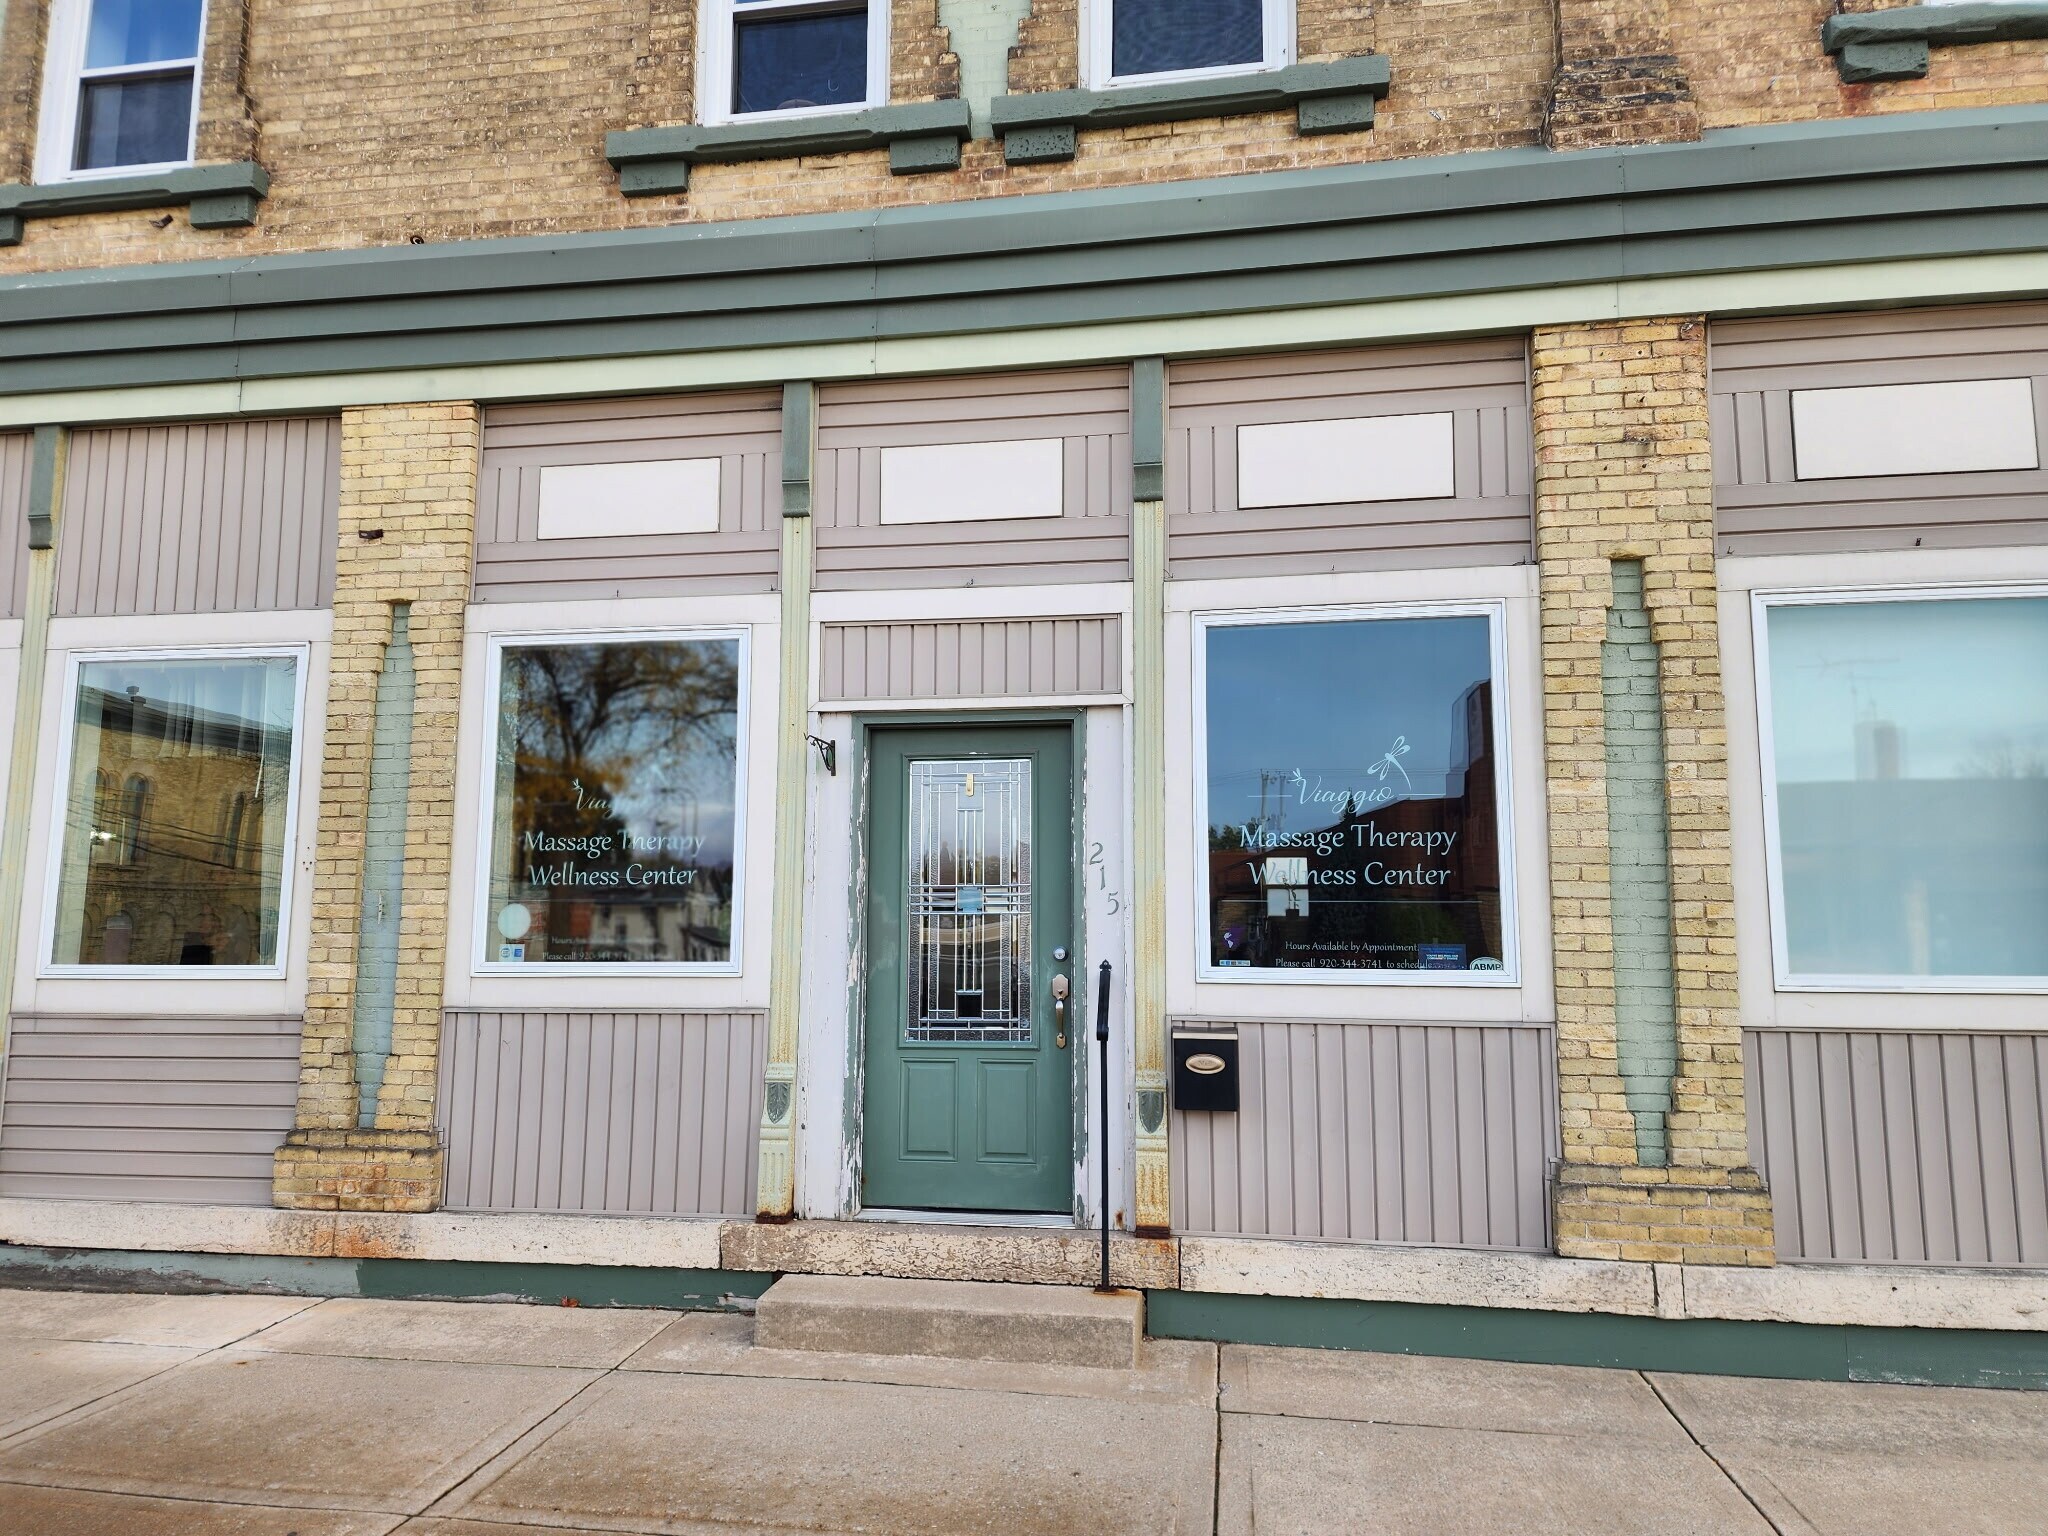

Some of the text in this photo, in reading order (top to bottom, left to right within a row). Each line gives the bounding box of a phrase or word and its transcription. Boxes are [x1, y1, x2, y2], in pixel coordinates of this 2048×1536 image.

[1297, 774, 1395, 814] Viaggio
[524, 828, 705, 859] Massage Therapy
[1239, 820, 1456, 856] Massage Therapy
[528, 861, 698, 886] Wellness Center
[1246, 858, 1451, 885] Wellness Center
[542, 951, 563, 961] Please
[1285, 941, 1311, 950] Hours
[1311, 941, 1349, 951] Available
[1350, 941, 1361, 954] by
[1275, 959, 1300, 968] Please
[1301, 958, 1316, 968] call
[1320, 959, 1382, 969] 920-344-3741
[1386, 960, 1395, 969] to
